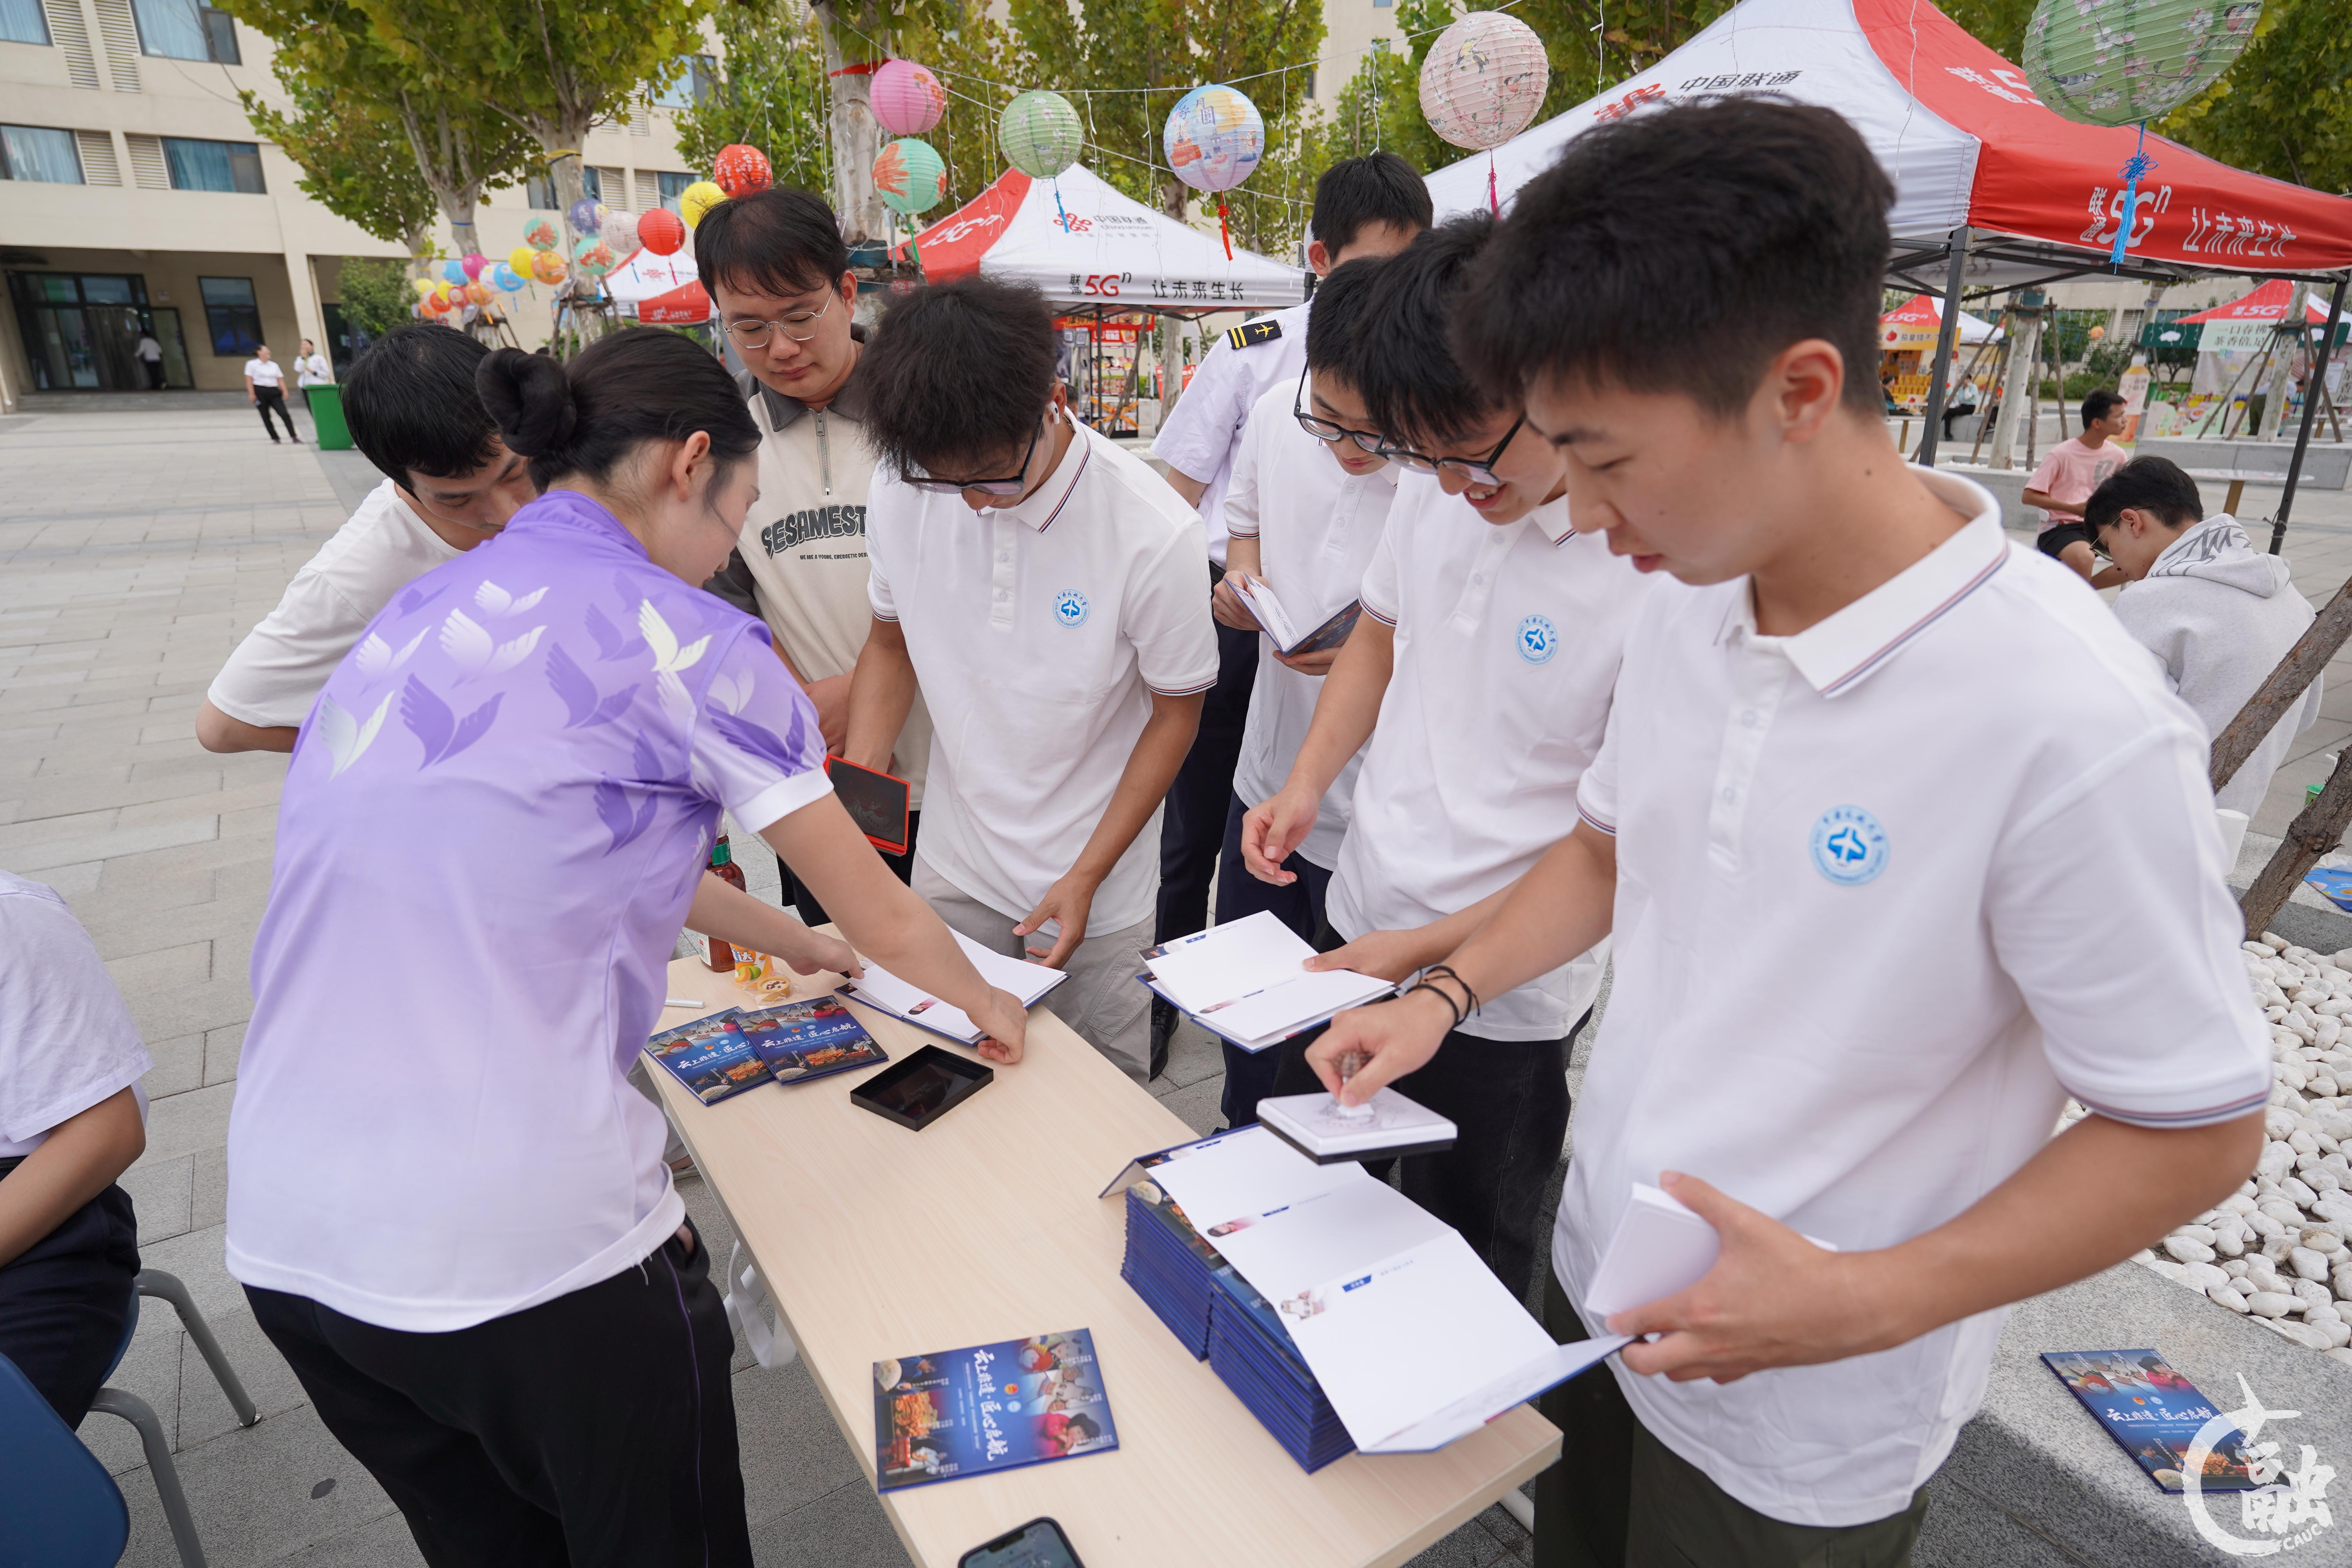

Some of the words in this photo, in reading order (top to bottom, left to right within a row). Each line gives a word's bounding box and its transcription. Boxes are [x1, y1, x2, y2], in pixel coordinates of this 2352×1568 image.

[1679, 70, 1804, 91] 中国联通
[1093, 215, 1147, 224] 中国联通
[2080, 186, 2107, 242] 联通
[2182, 207, 2297, 257] 让未来生长
[1070, 274, 1082, 295] 联通
[1152, 279, 1244, 300] 让未来生长
[677, 1040, 750, 1069] 云上非遗·匠心
